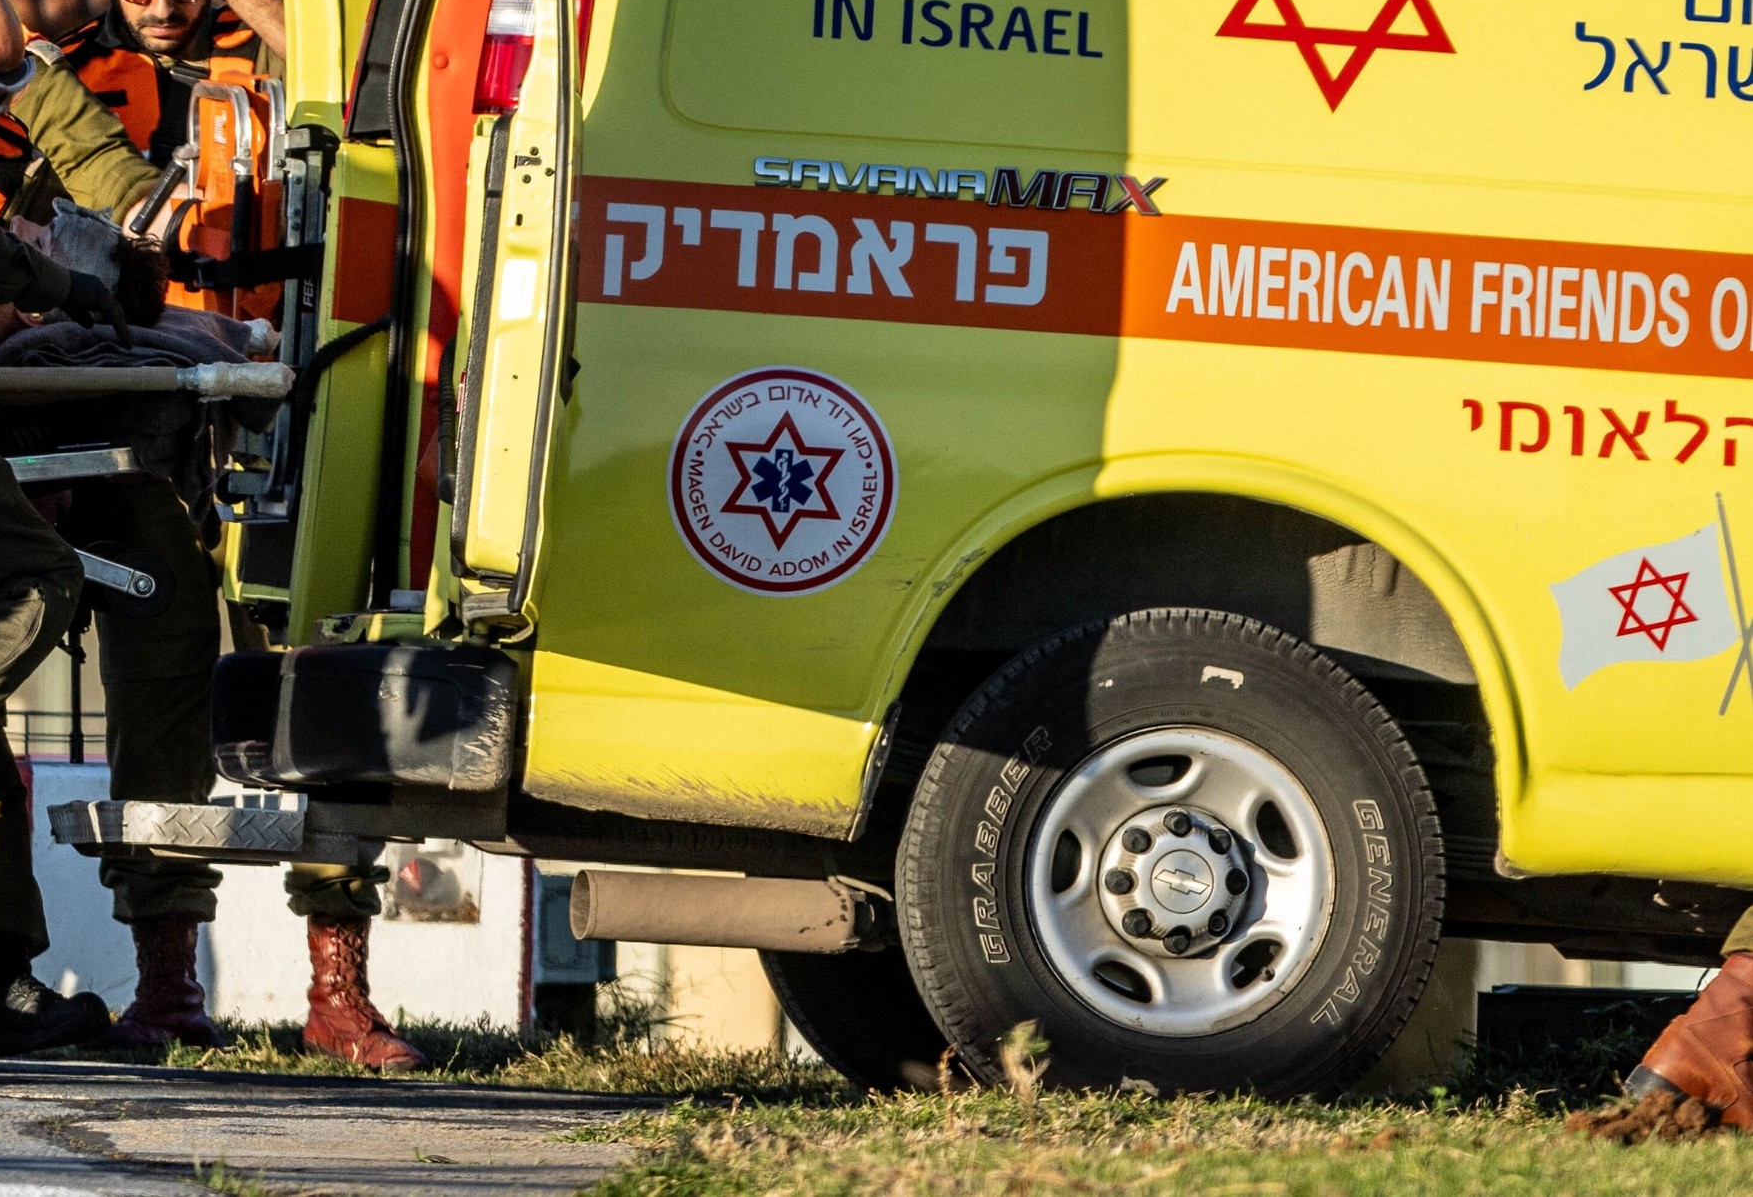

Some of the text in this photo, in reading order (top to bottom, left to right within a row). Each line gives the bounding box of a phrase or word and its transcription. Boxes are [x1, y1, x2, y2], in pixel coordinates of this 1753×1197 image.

[602, 202, 1050, 307] פראמדיק
[1166, 241, 1753, 353] AMERICAN FRIENDS O
[693, 391, 762, 450] בישראל
[768, 385, 822, 408] אדום
[687, 458, 878, 577] MAGEN DAVID ADOM IN ISRAEL
[972, 725, 1053, 964] GRABBER
[1310, 799, 1393, 1026] GENERAL
